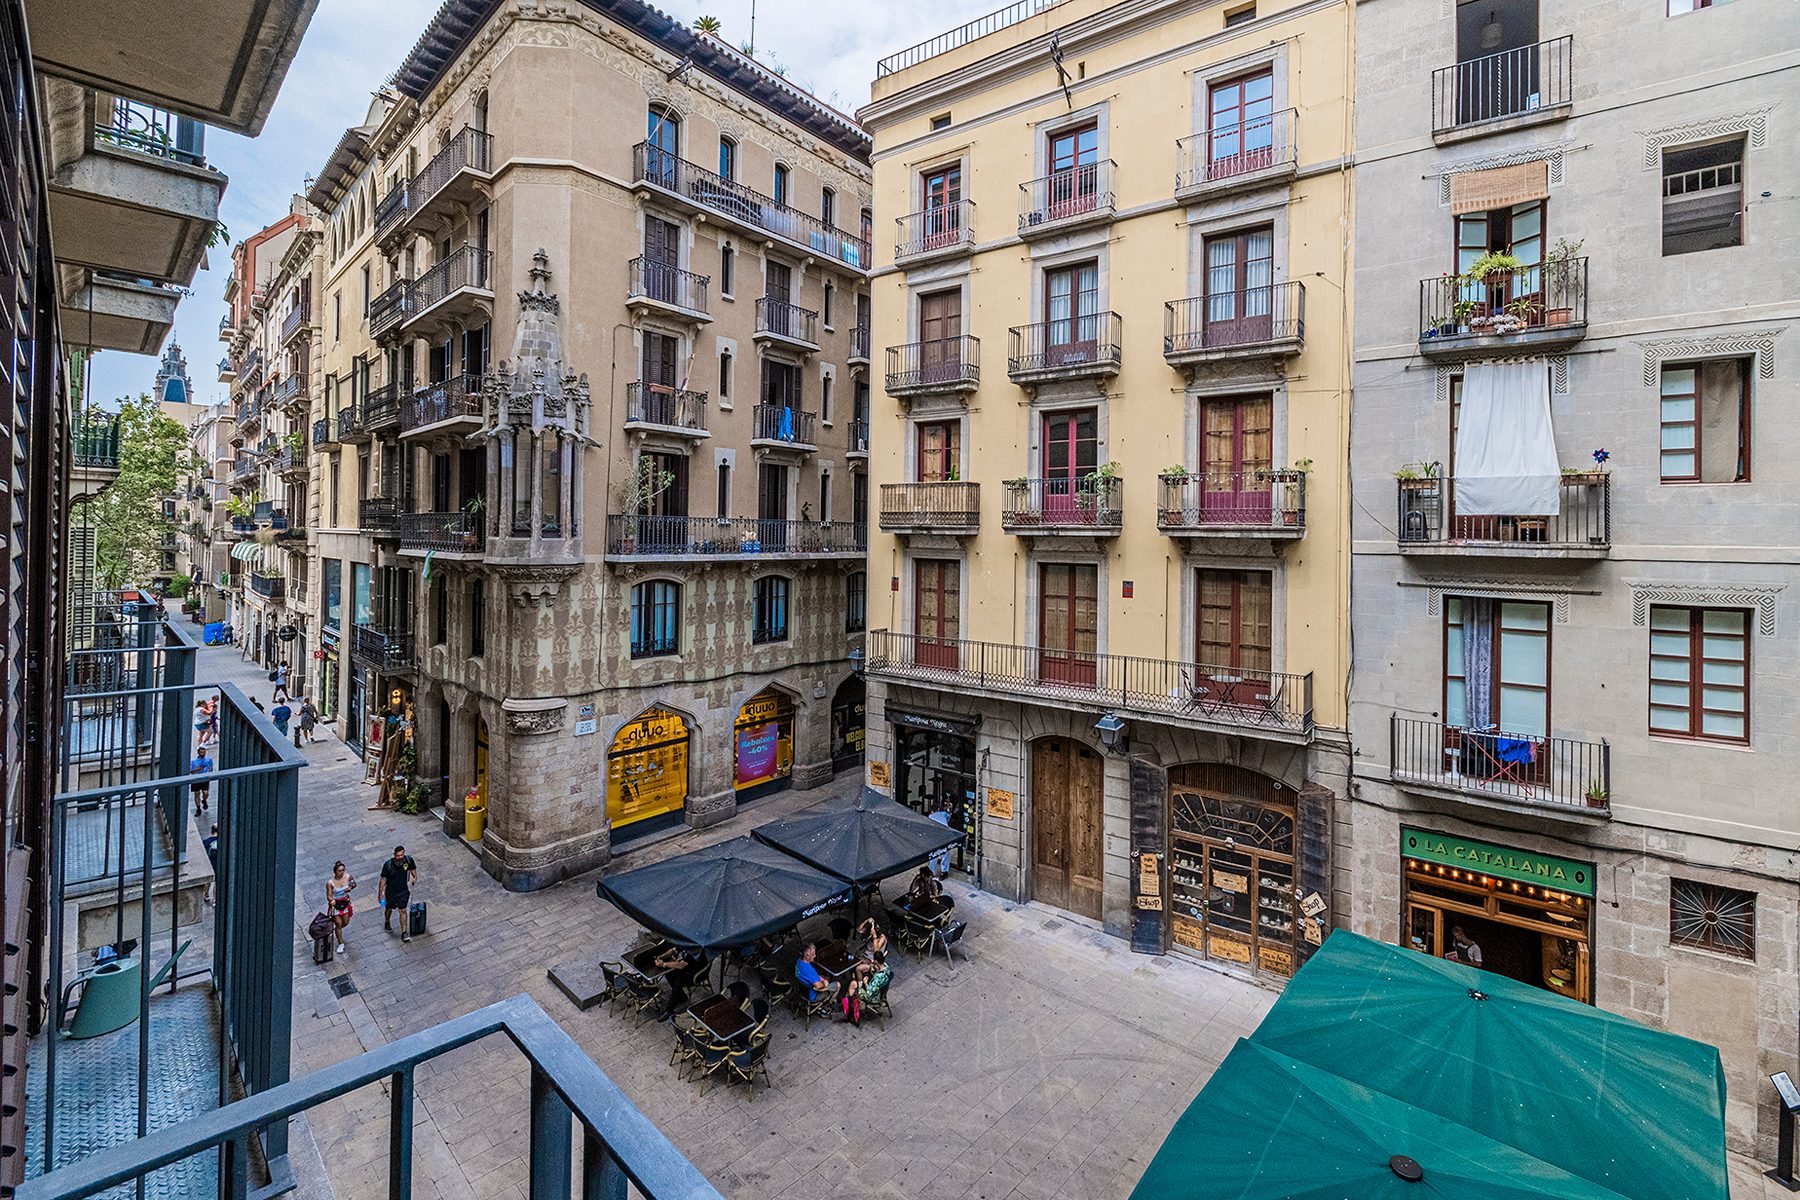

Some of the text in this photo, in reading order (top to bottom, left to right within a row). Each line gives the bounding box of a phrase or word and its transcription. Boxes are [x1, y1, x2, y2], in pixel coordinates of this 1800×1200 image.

[628, 725, 664, 740] duuo
[741, 735, 775, 749] Rebaixes
[748, 744, 768, 755] -40%
[1424, 839, 1448, 855] LA
[1453, 846, 1568, 881] CATALANA
[1139, 897, 1160, 908] Shop
[1300, 898, 1320, 913] Shop
